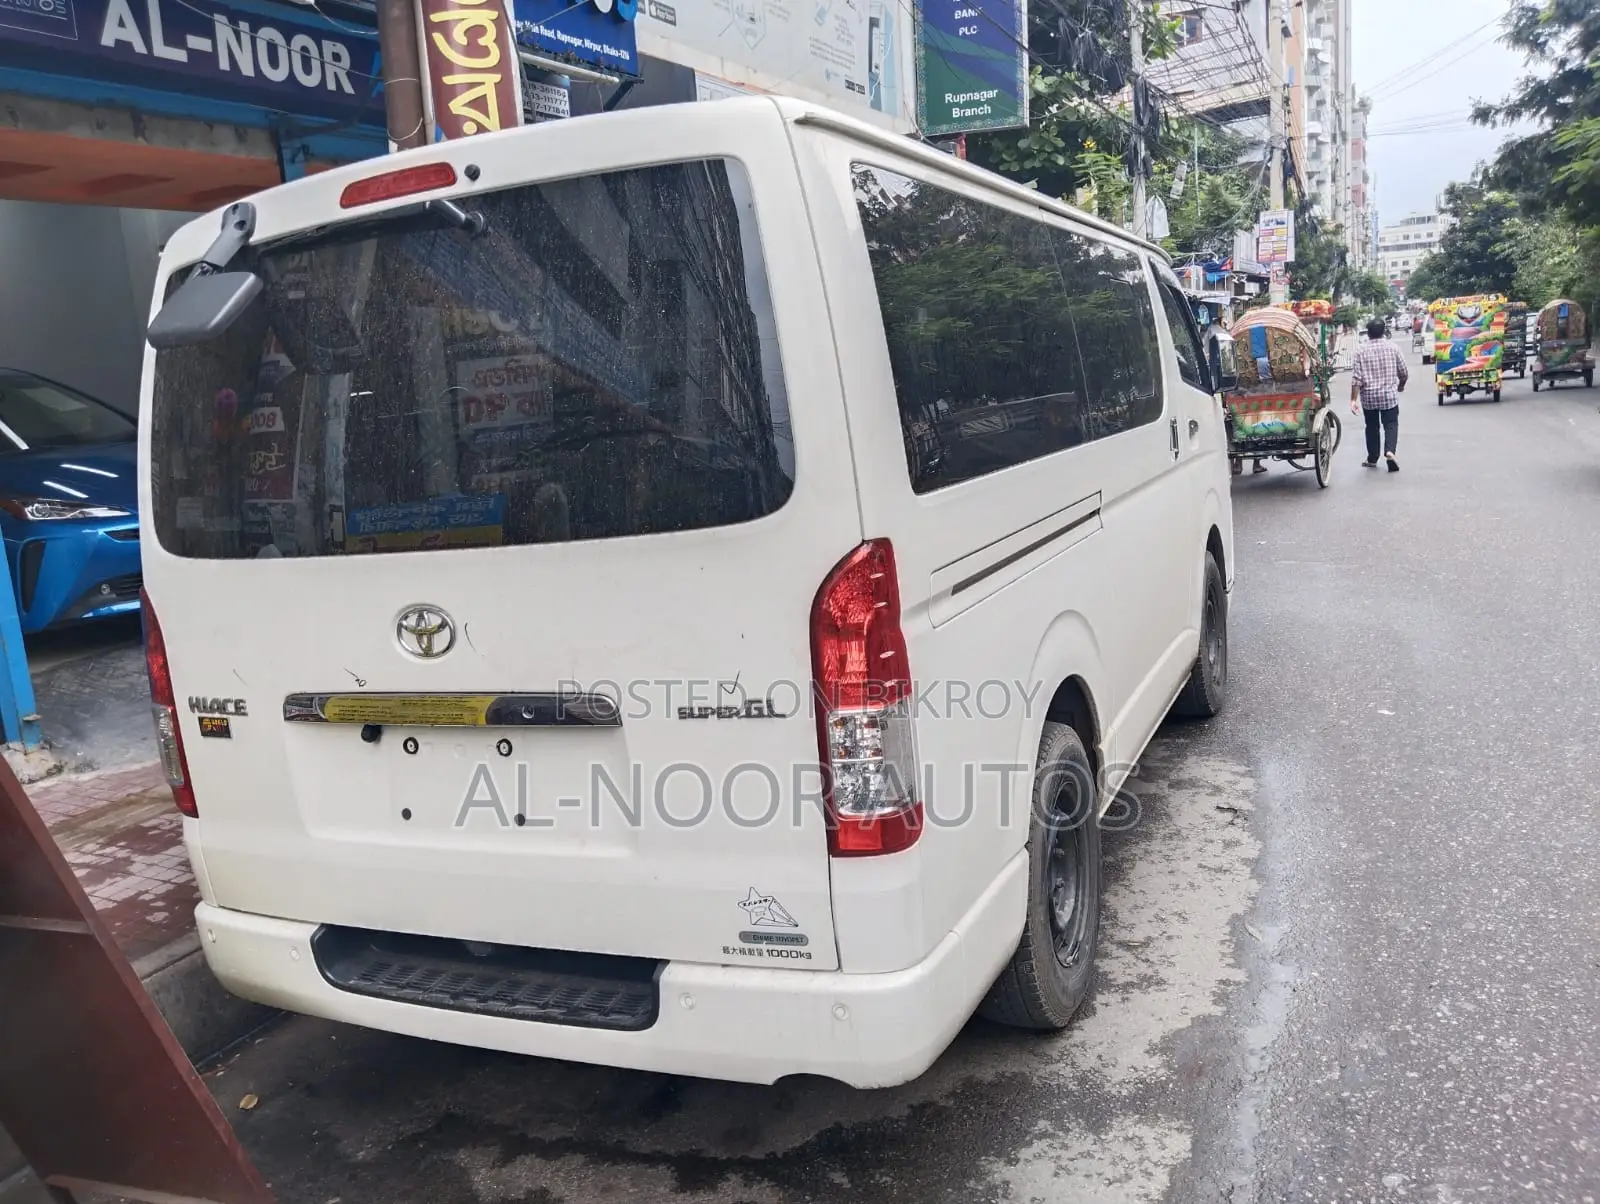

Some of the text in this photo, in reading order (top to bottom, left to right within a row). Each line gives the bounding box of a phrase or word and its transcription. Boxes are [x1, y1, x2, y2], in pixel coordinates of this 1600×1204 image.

[958, 25, 978, 37] PLC
[100, 0, 356, 95] AL-NOOR
[944, 89, 998, 104] Rupnagar
[952, 104, 991, 118] Branch
[188, 696, 248, 716] HIACE
[766, 948, 812, 960] 1000kg
